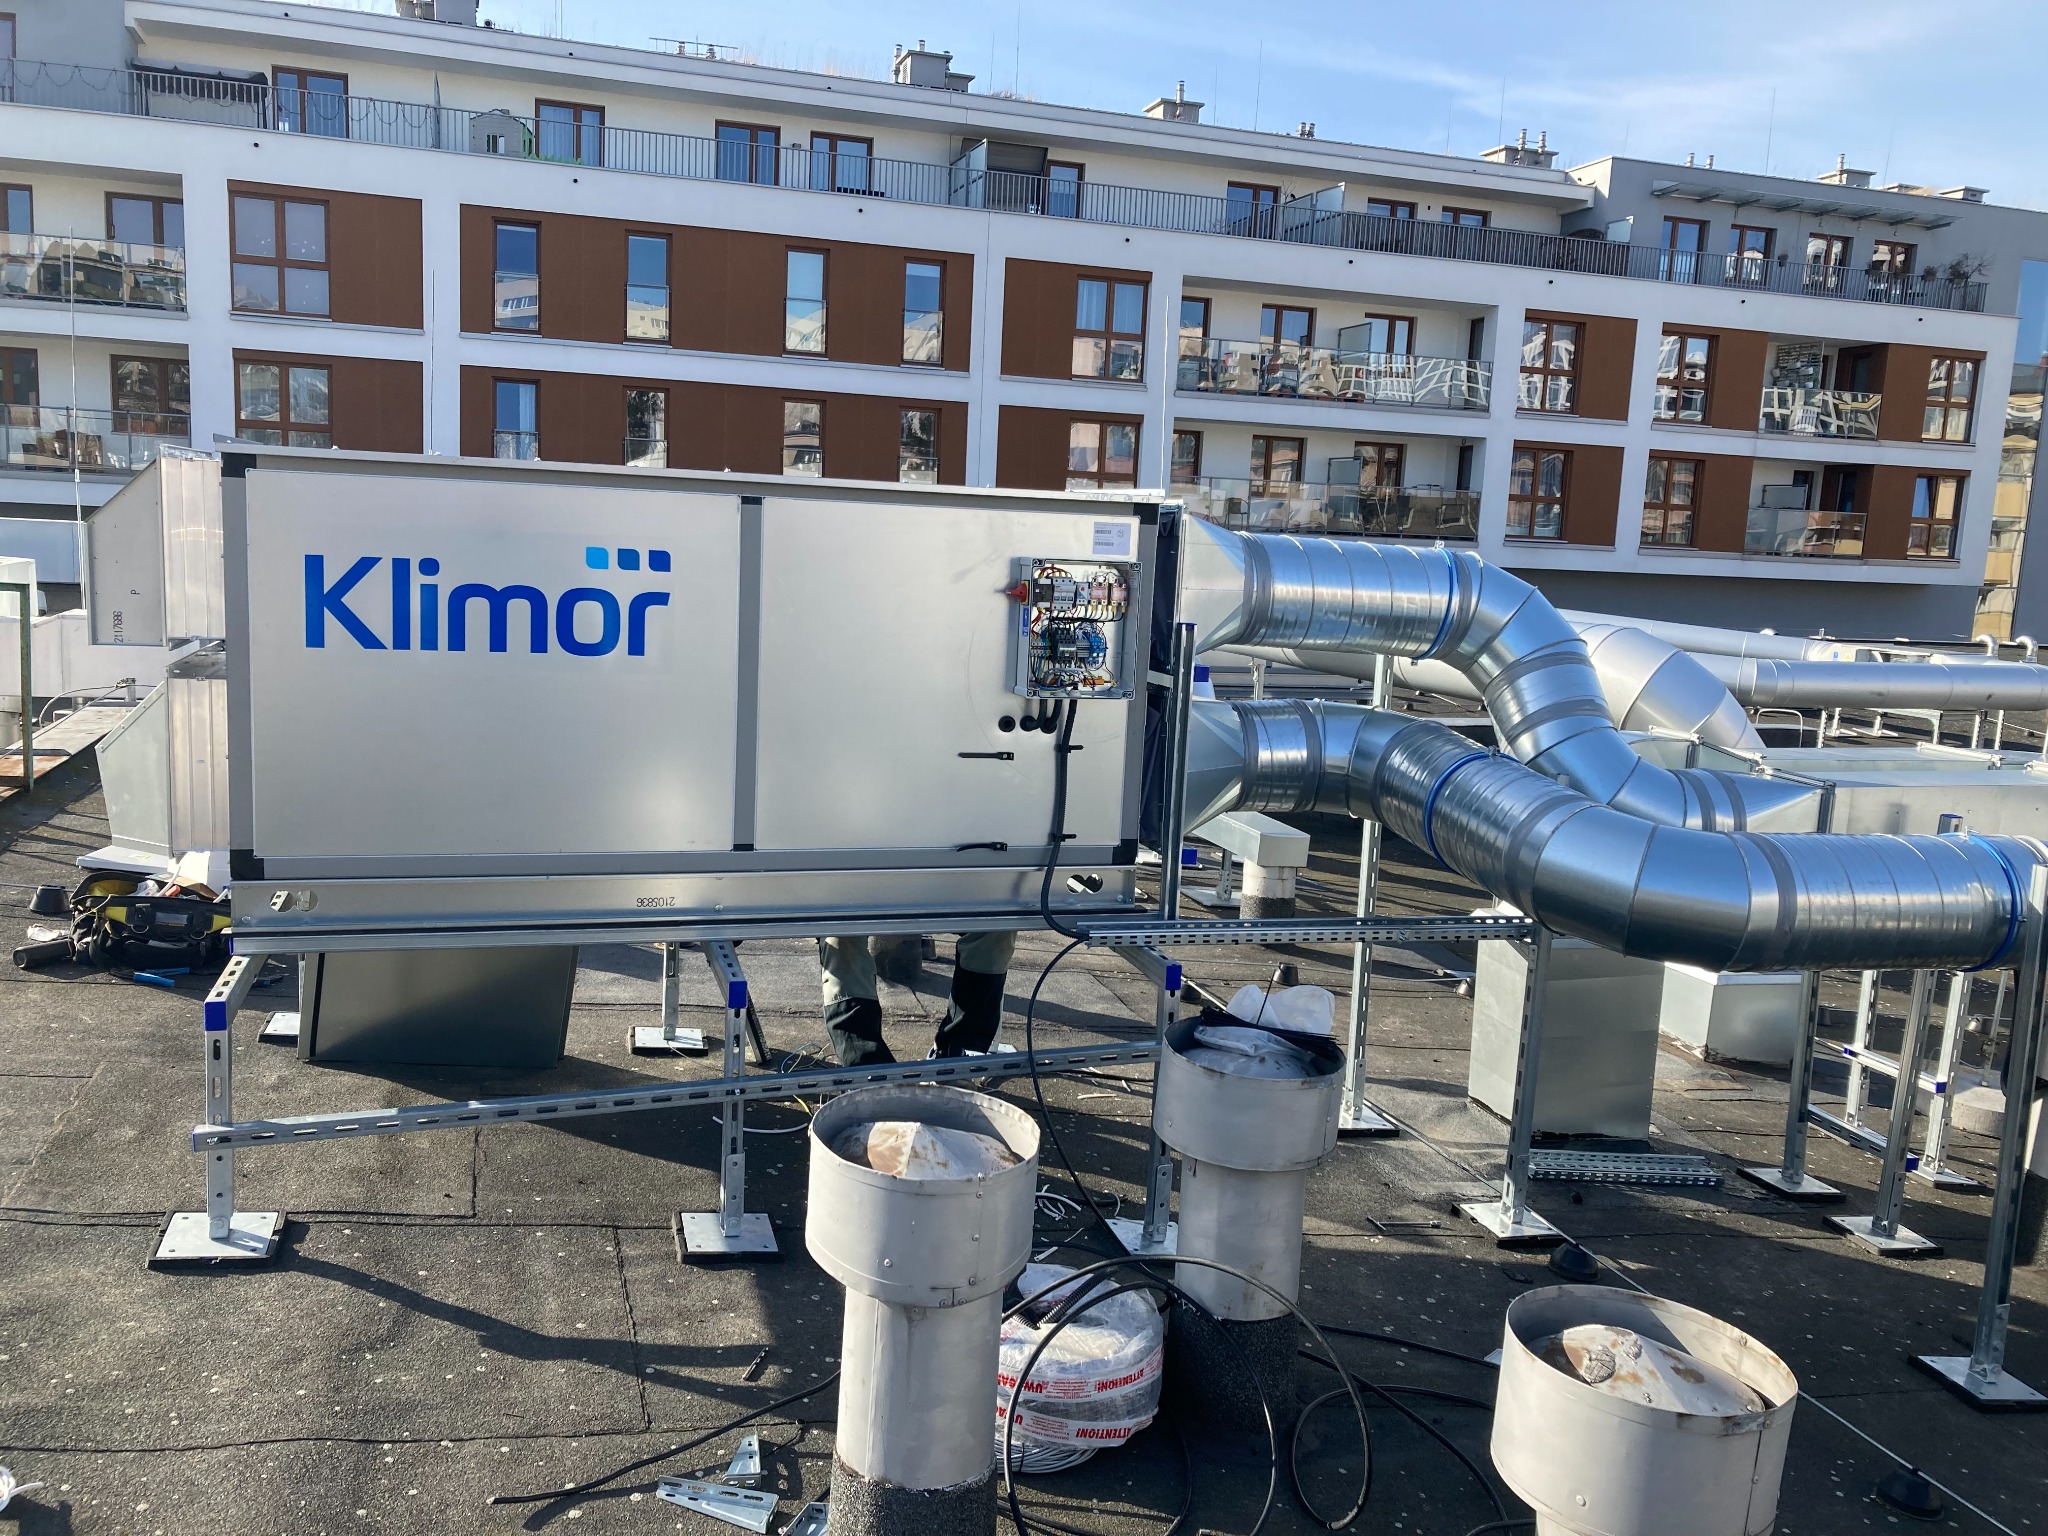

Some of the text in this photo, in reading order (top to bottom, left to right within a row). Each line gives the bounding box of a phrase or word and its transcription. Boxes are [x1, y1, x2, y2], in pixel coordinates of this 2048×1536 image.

[304, 552, 672, 657] Klimor
[636, 896, 676, 908] 2105836
[1075, 1427, 1133, 1440] ATTENTION!
